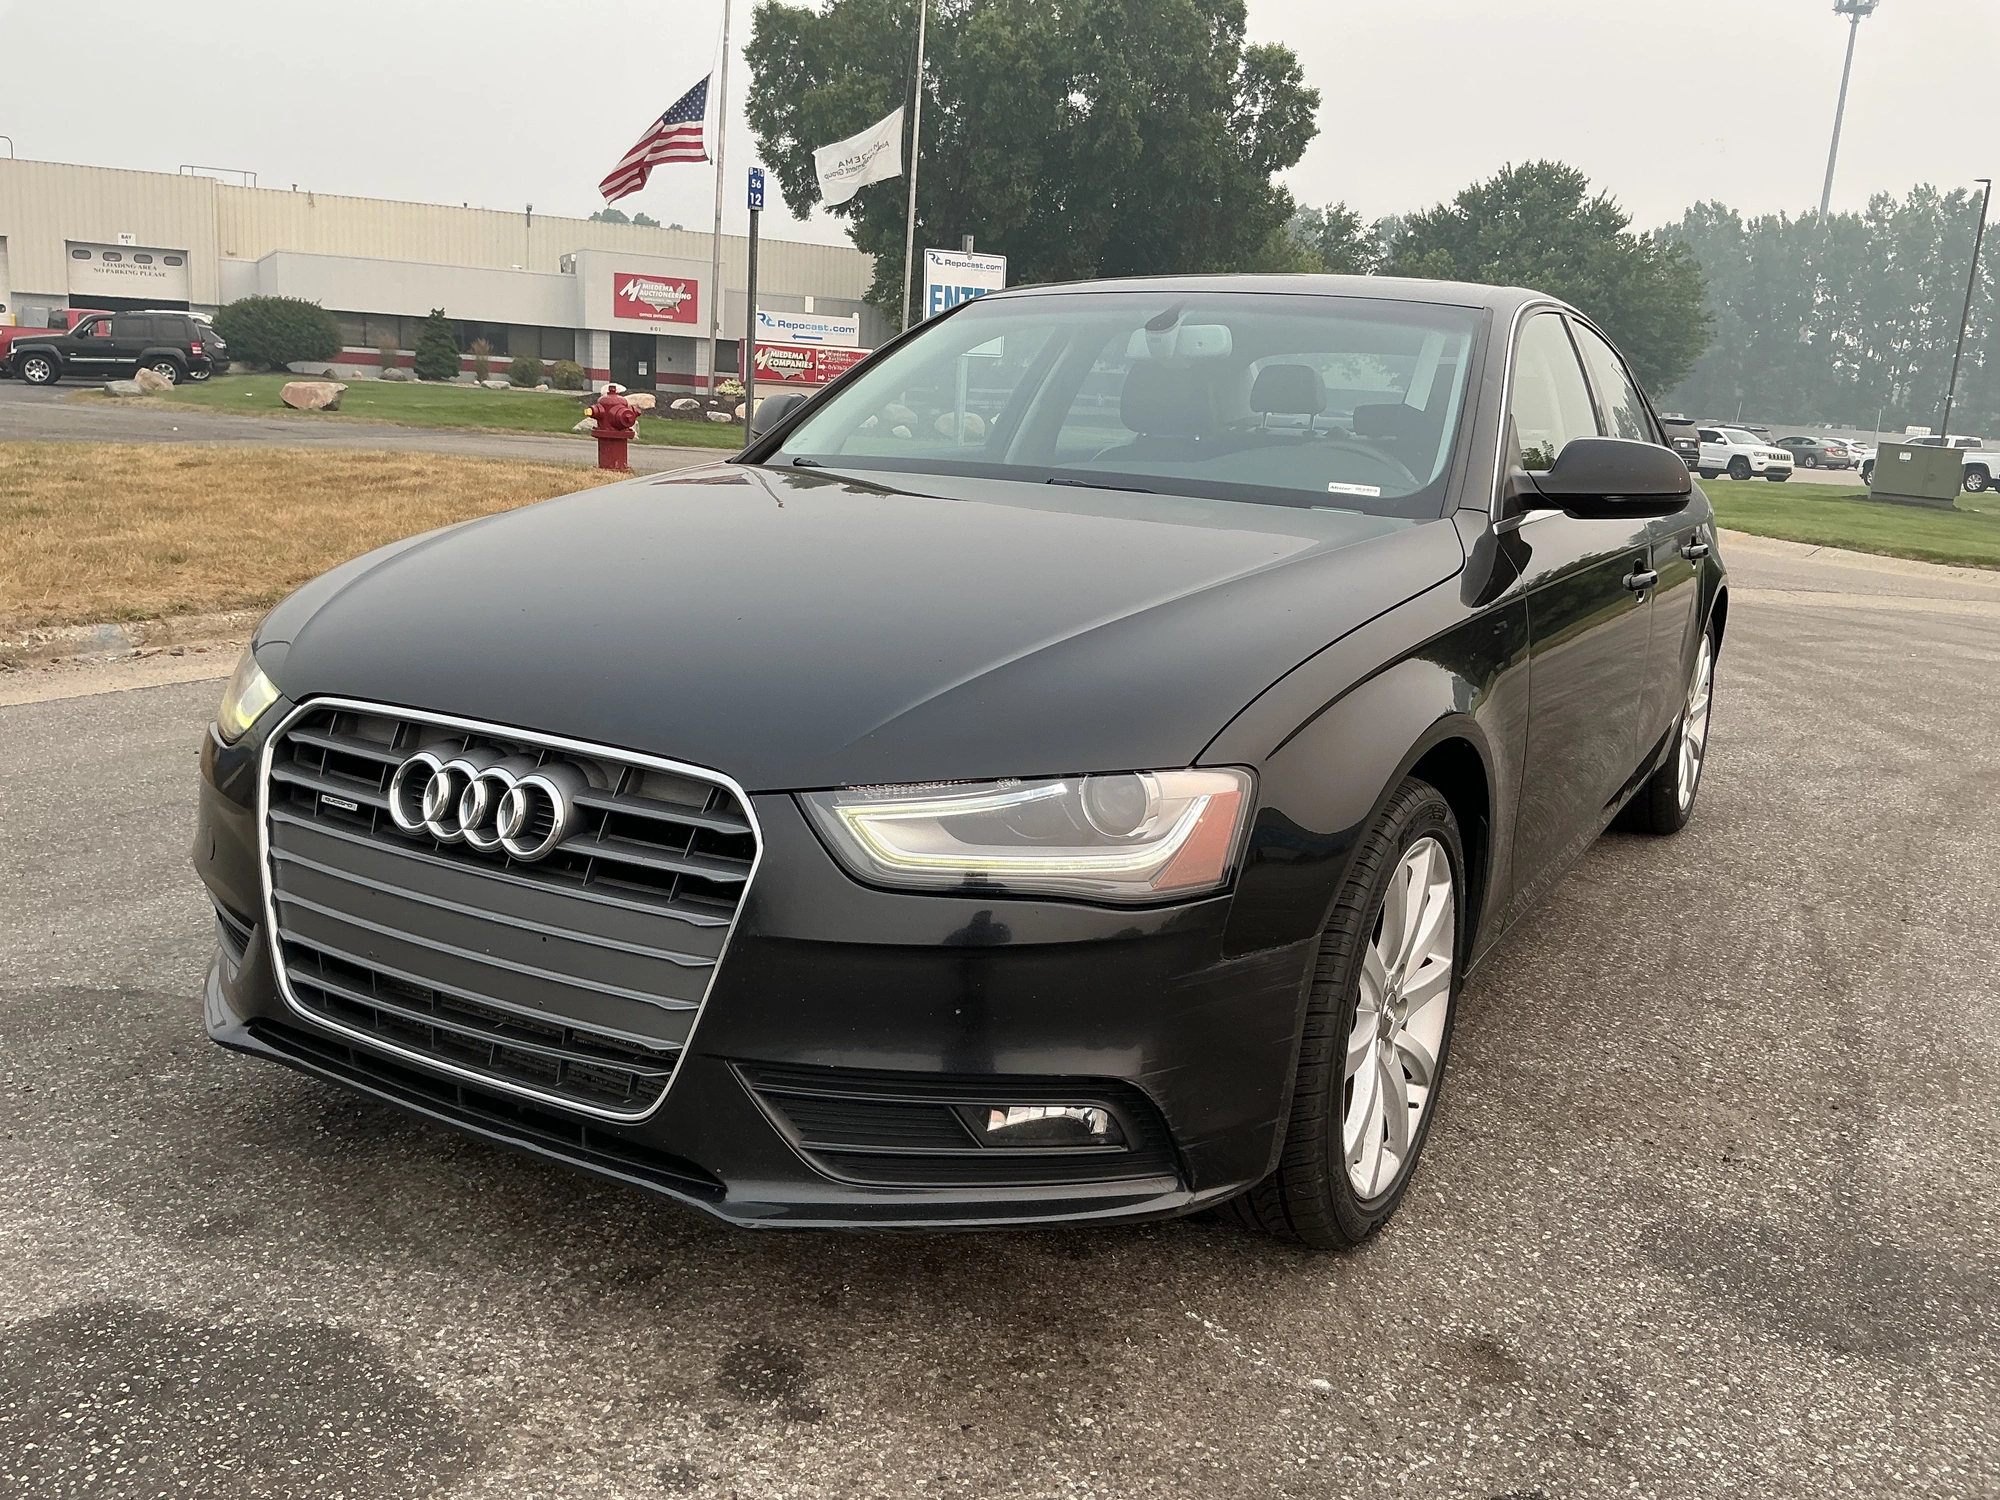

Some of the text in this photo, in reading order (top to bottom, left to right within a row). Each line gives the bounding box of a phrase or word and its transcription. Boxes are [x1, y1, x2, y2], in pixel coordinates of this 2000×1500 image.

[751, 178, 762, 189] 56
[750, 192, 762, 206] 12
[945, 259, 1002, 271] Repocast.com
[106, 268, 138, 276] PARKING
[642, 283, 674, 292] MIEDEMA
[640, 290, 692, 300] AUCTIONEERING
[777, 320, 855, 334] Repocast.com
[770, 350, 804, 360] MIEDEMA
[768, 359, 813, 369] COMPANIES
